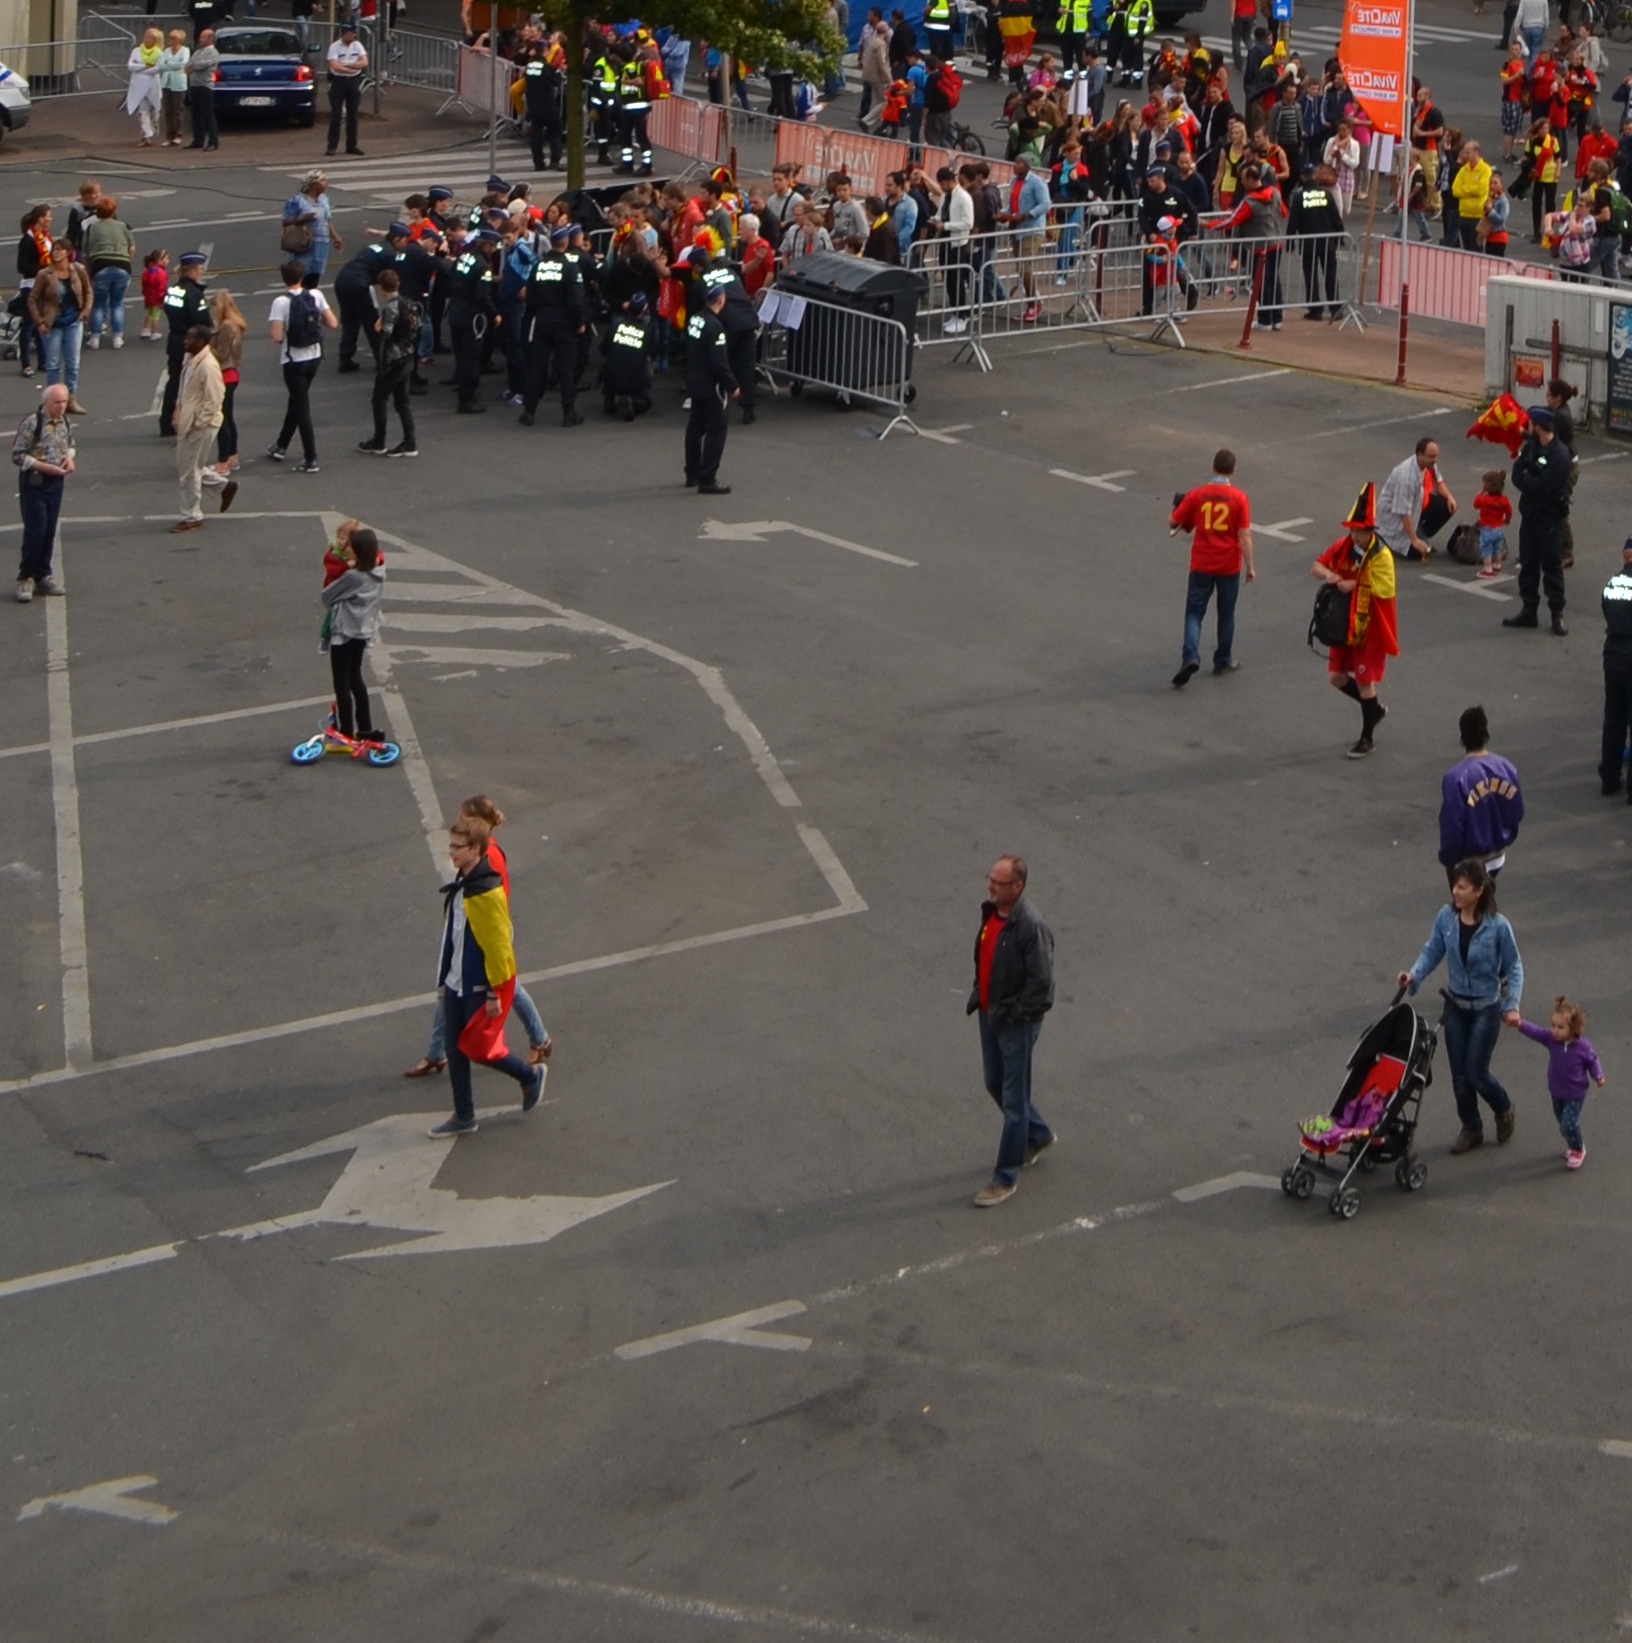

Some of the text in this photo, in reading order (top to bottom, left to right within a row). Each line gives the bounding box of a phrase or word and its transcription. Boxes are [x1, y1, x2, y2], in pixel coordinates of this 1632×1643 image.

[537, 260, 563, 271] Police
[536, 270, 563, 282] Politie
[617, 323, 645, 340] Police
[612, 333, 643, 350] Politie
[1201, 501, 1229, 531] 12
